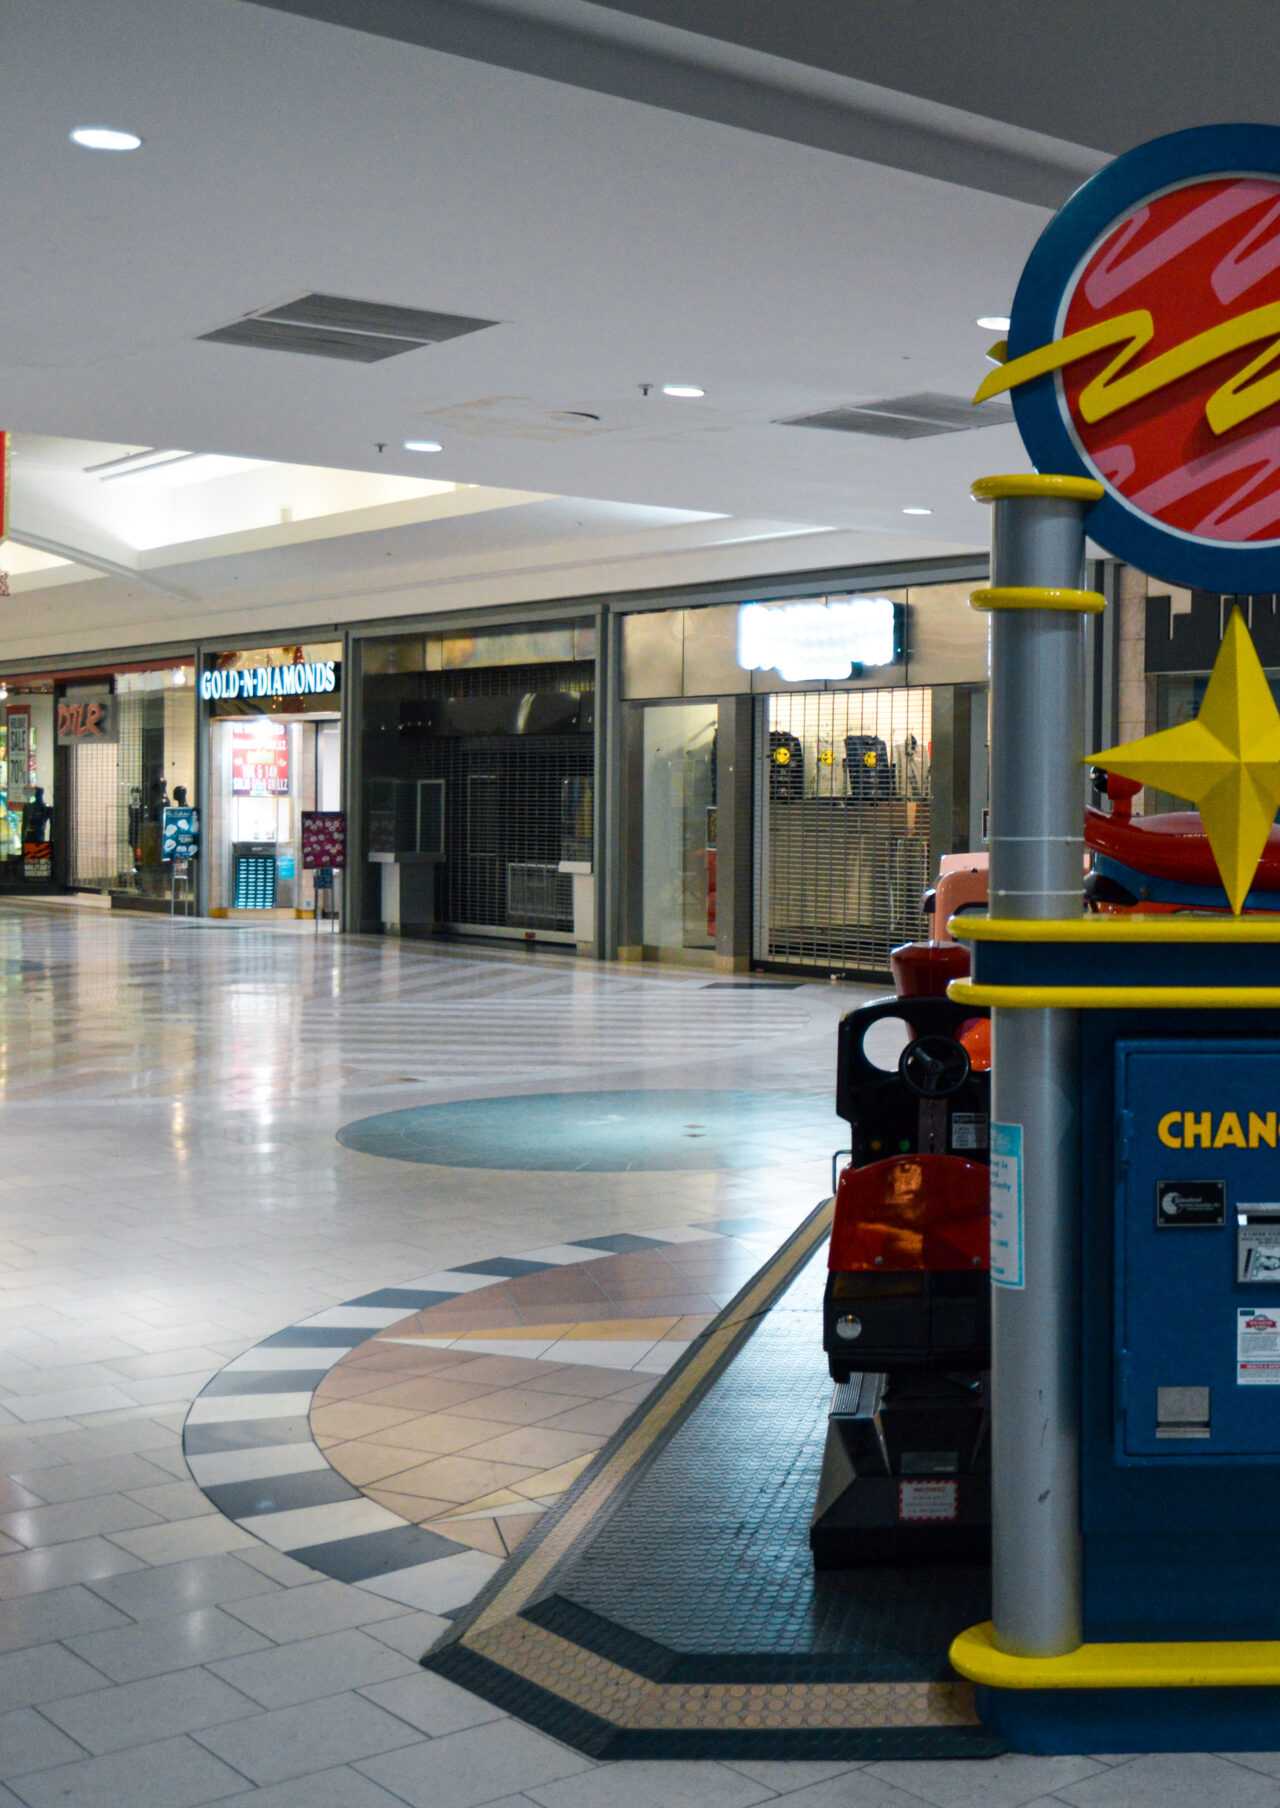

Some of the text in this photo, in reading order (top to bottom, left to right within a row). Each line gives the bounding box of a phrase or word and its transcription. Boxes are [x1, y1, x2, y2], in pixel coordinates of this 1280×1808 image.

[57, 704, 101, 735] DTLR
[10, 730, 26, 752] SALE
[10, 759, 27, 785] 70%
